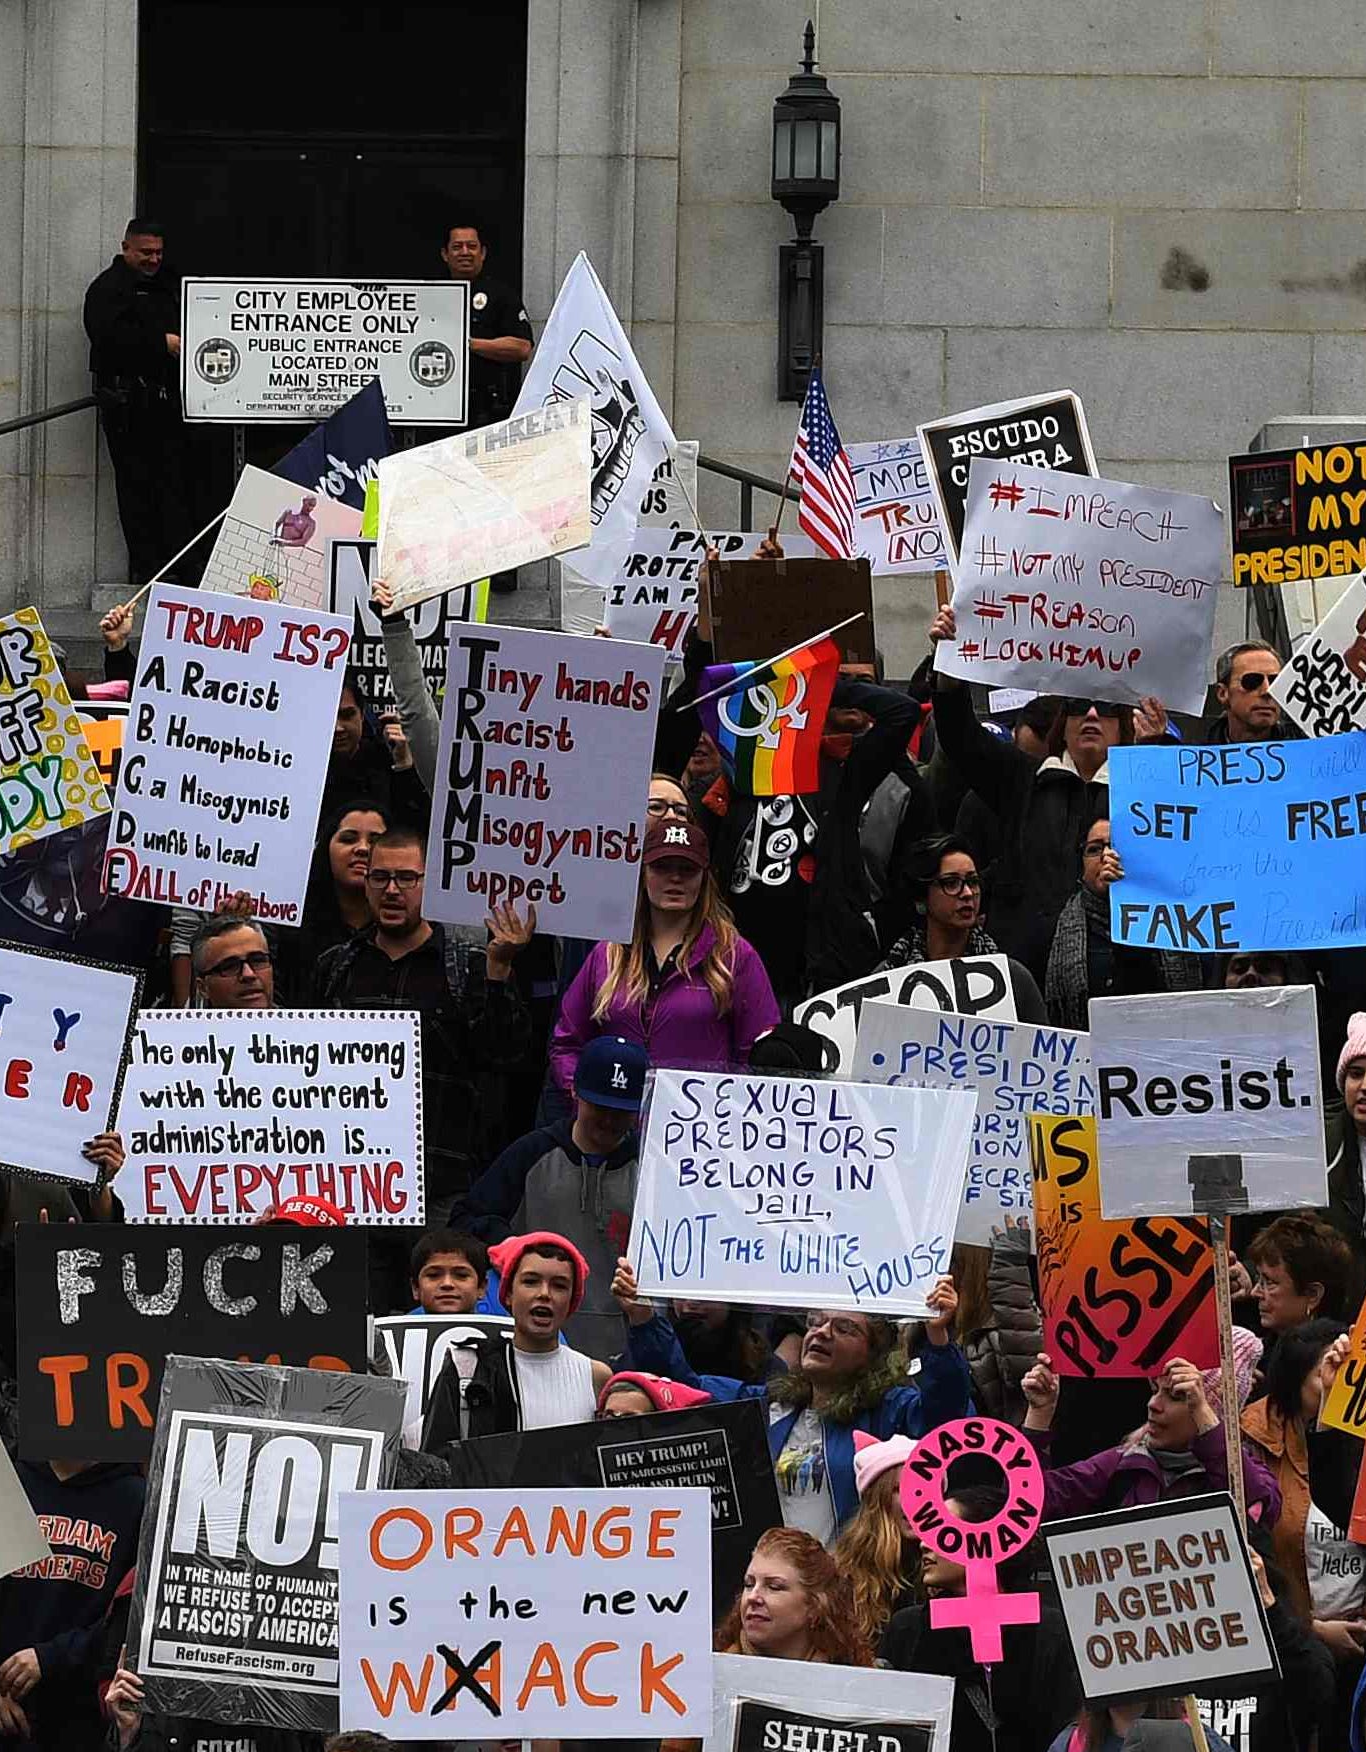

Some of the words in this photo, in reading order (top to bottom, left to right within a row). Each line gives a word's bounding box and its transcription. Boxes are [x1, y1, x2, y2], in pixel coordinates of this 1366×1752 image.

[235, 291, 286, 309] CITY
[297, 292, 416, 311] EMPLOYEE
[230, 314, 352, 333] ENTRANCE
[363, 316, 419, 334] ONLY
[249, 339, 306, 353] PUBLIC
[314, 340, 402, 354] ENTRANCE
[272, 356, 346, 370] LOCATED
[355, 357, 379, 370] ON
[262, 393, 304, 401] SECURITY
[307, 393, 348, 401] SERVICES
[269, 374, 309, 386] MAIN
[949, 415, 1060, 458] ESCUDO
[988, 474, 1189, 543] #IMPEACH
[158, 600, 263, 656] TRUMP
[273, 621, 351, 672] IS?
[459, 637, 541, 710] Tiny
[555, 663, 650, 712] hands
[456, 689, 574, 752] Racist
[449, 740, 551, 801] Unfit
[444, 792, 641, 867] Misogynist
[1132, 802, 1197, 841] SET
[442, 840, 565, 908] Puppet
[138, 1083, 203, 1111] with
[213, 1079, 262, 1110] the
[271, 1083, 388, 1111] current
[1098, 1057, 1311, 1120] Resist.
[131, 1116, 325, 1157] administration
[343, 1127, 391, 1157] is...
[679, 1160, 815, 1189] BELONG
[835, 1164, 873, 1191] IN
[284, 1201, 338, 1225] RESIST
[635, 1212, 717, 1284] NOT
[719, 1236, 765, 1263] THE
[780, 1232, 863, 1274] WHITE
[847, 1236, 951, 1304] HOUSE
[56, 1243, 335, 1324] FUCK
[616, 1450, 644, 1467] HEY
[649, 1442, 708, 1462] TRUMP!
[910, 1421, 1032, 1481] NASTY
[678, 1473, 716, 1487] PUTIN
[369, 1505, 681, 1572] ORANGE
[913, 1497, 1038, 1559] WOMAN
[1059, 1523, 1233, 1589] IMPEACH
[1322, 1553, 1361, 1576] Hate
[164, 1584, 186, 1604] WE
[191, 1587, 251, 1611] REFUSE
[256, 1594, 276, 1614] TO
[459, 1585, 538, 1620] the
[583, 1588, 689, 1615] new
[1093, 1577, 1216, 1627] AGENT
[176, 1647, 315, 1676] RefuseFascism.org
[1085, 1611, 1250, 1671] ORANGE
